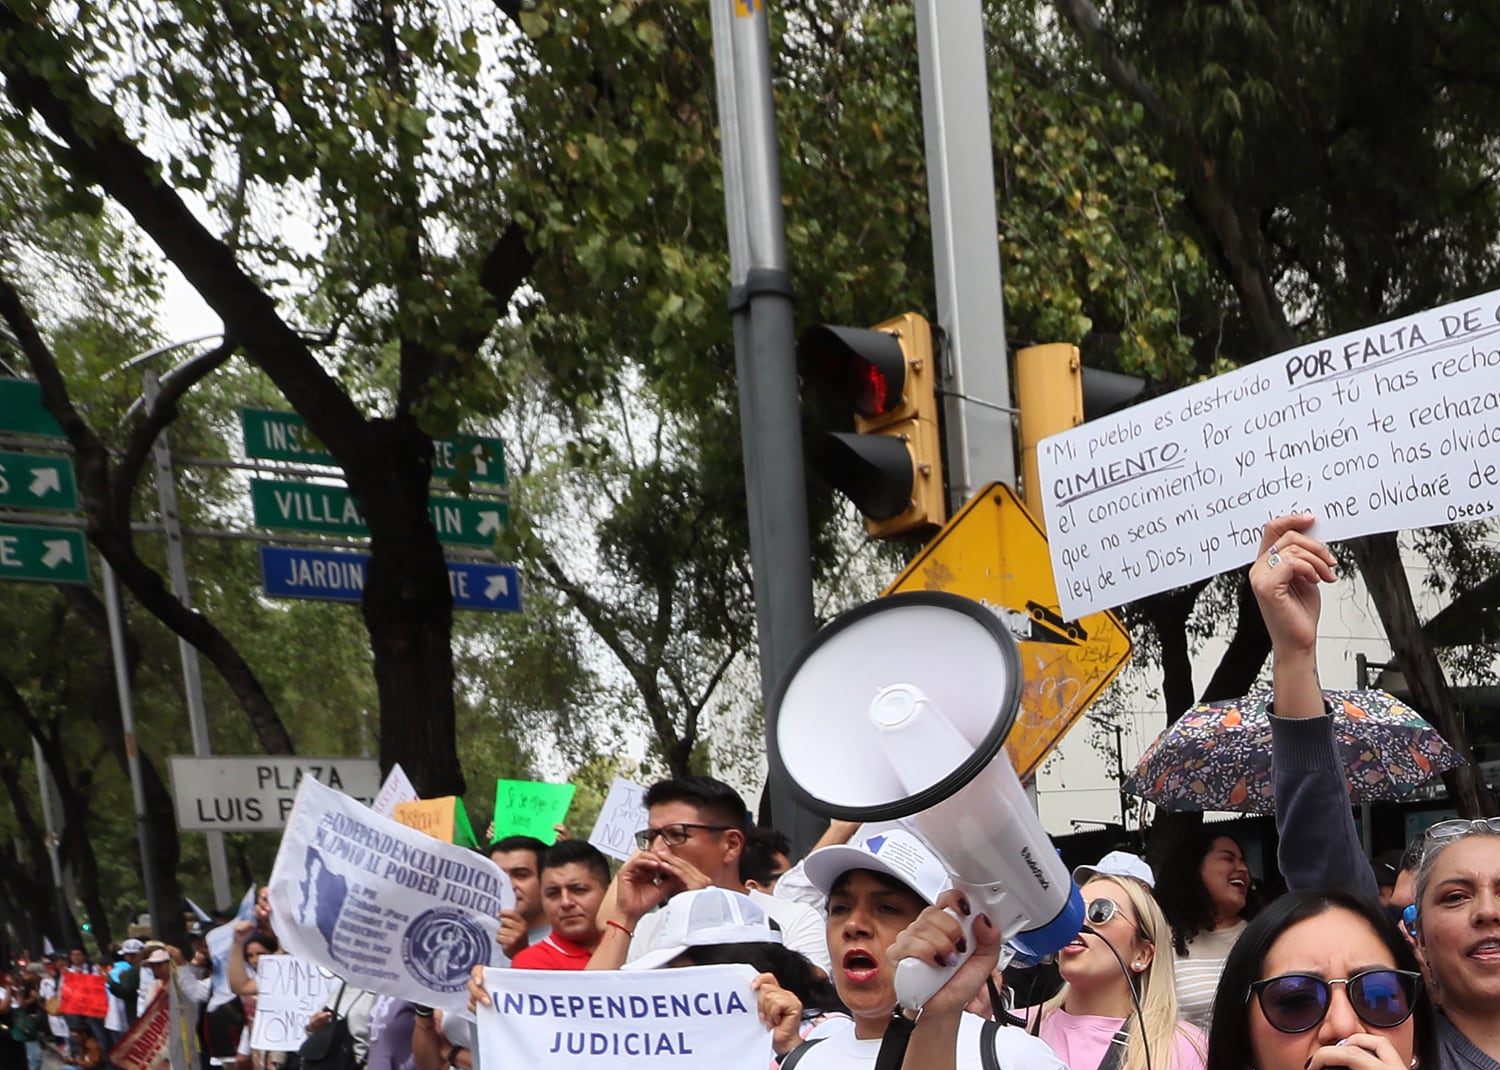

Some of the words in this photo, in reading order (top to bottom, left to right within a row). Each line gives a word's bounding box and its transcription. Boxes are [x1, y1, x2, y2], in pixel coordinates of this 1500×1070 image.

[1088, 421, 1143, 460] pueblo
[1153, 411, 1175, 432] es
[1284, 349, 1338, 386] POR
[1342, 324, 1428, 370] FALTA
[1439, 306, 1483, 339] DE
[1053, 441, 1188, 501] CIMIENTO.
[1203, 422, 1233, 450] Por
[1243, 393, 1322, 436] cuanto
[1331, 375, 1361, 406] tú
[1374, 369, 1420, 397] has
[1058, 504, 1077, 535] el
[1087, 461, 1225, 525] conocimiento,
[1235, 449, 1256, 478] yo
[1264, 417, 1360, 463] también
[1367, 407, 1398, 434] te
[1061, 543, 1092, 573] que
[1099, 532, 1121, 552] no
[1127, 515, 1169, 544] seas
[1174, 503, 1201, 528] mi
[1205, 465, 1313, 520] sacerdote;
[1321, 452, 1380, 482] como
[1389, 439, 1433, 466] has
[1065, 577, 1095, 604] ley
[1097, 565, 1117, 591] de
[1121, 557, 1142, 581] tu
[1147, 545, 1194, 575] Dios,
[1200, 535, 1221, 567] yo
[1324, 495, 1360, 520] me
[1368, 472, 1451, 511] olvidaré
[1467, 458, 1499, 490] de
[1447, 499, 1495, 522] Oseas
[196, 798, 263, 823] LUIS
[383, 860, 441, 897] PODER
[491, 990, 749, 1019] INDEPENDENCIA
[549, 1031, 693, 1056] JUDICIAL
